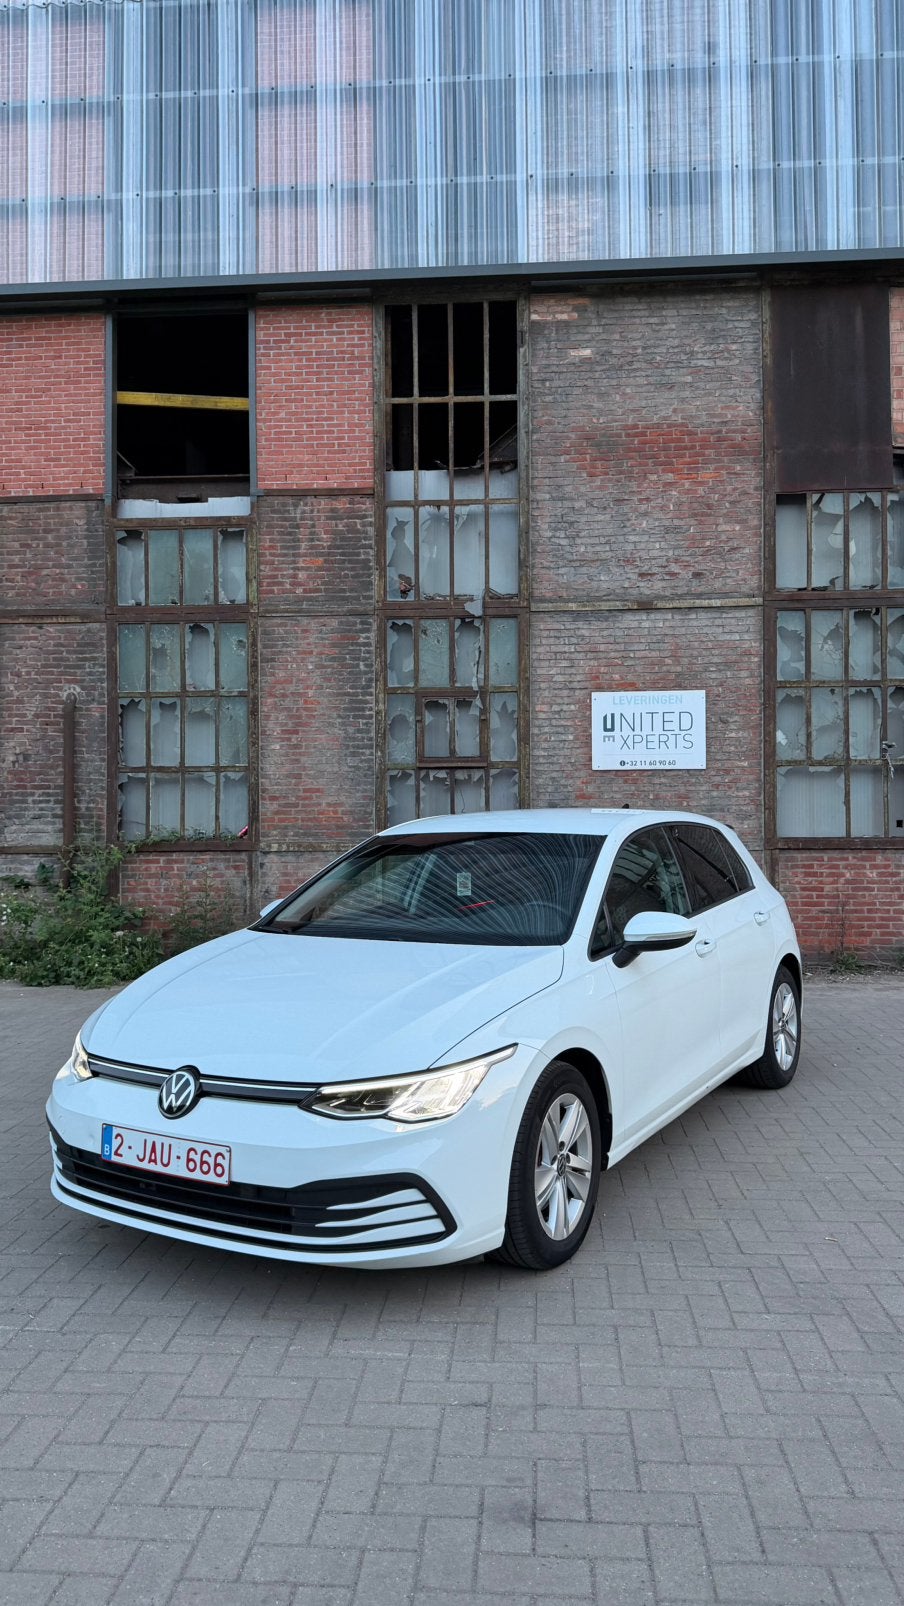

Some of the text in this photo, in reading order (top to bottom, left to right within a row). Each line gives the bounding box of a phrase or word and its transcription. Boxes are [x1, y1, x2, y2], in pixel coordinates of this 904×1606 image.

[612, 695, 683, 705] LEVERINGEN
[602, 711, 694, 732] UNITED
[104, 1132, 225, 1178] B 2-JAU-666
